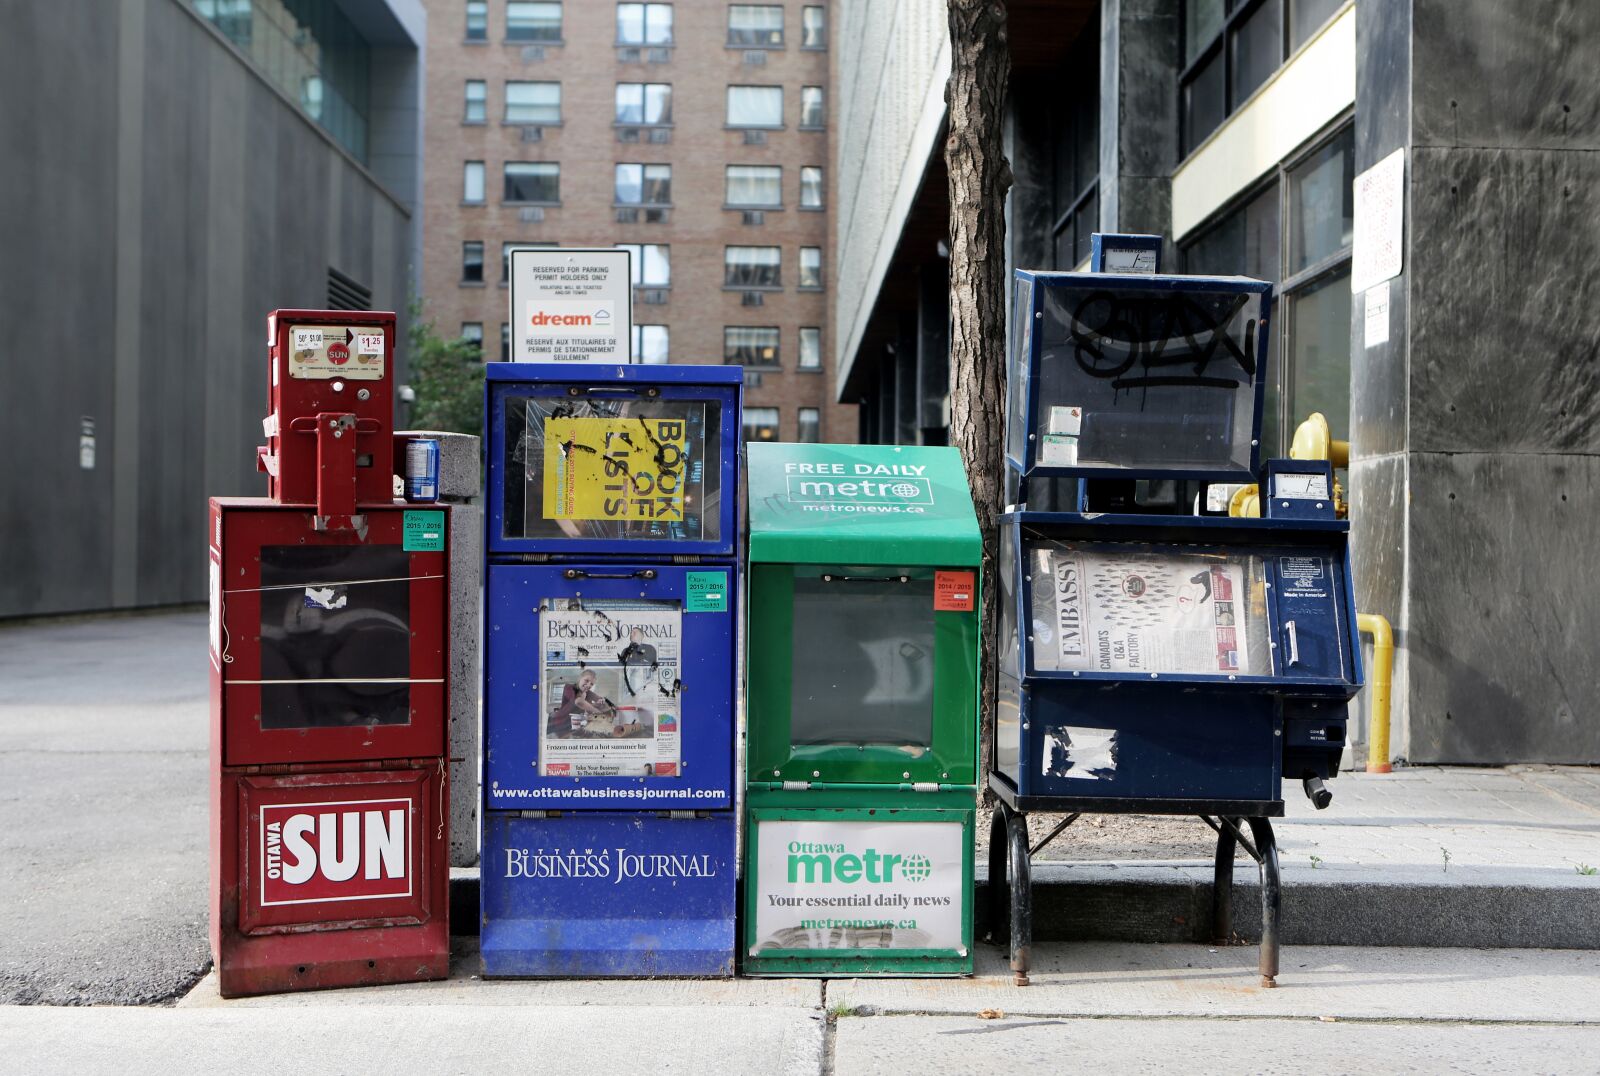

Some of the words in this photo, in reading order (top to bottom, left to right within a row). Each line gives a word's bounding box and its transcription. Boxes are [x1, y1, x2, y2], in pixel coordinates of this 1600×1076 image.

[531, 311, 591, 326] dream
[362, 337, 380, 347] $1.25
[604, 432, 630, 517] LISTS
[656, 422, 682, 519] BOOK
[784, 463, 846, 474] FREE
[854, 464, 927, 476] DAILY
[631, 471, 655, 518] OF
[800, 480, 920, 498] metro
[803, 504, 925, 514] metronews.ca
[547, 620, 612, 638] BUSINESS
[615, 620, 676, 642] JORNAL
[1098, 630, 1111, 670] CANADA'S
[1113, 640, 1125, 660] Q&A
[1127, 632, 1140, 668] FACTORY
[493, 788, 725, 800] www.ottawabusinessjournal.com
[267, 821, 281, 880] OTTAWA
[282, 810, 405, 885] SUN
[788, 841, 845, 853] Ottawa
[504, 848, 609, 878] BUSINESS
[614, 848, 715, 884] JOURNAL
[788, 848, 931, 884] metro
[768, 894, 804, 906] Your
[806, 894, 872, 906] essential
[874, 894, 910, 909] daily
[913, 896, 950, 906] news
[801, 918, 916, 930] metronews.ca
